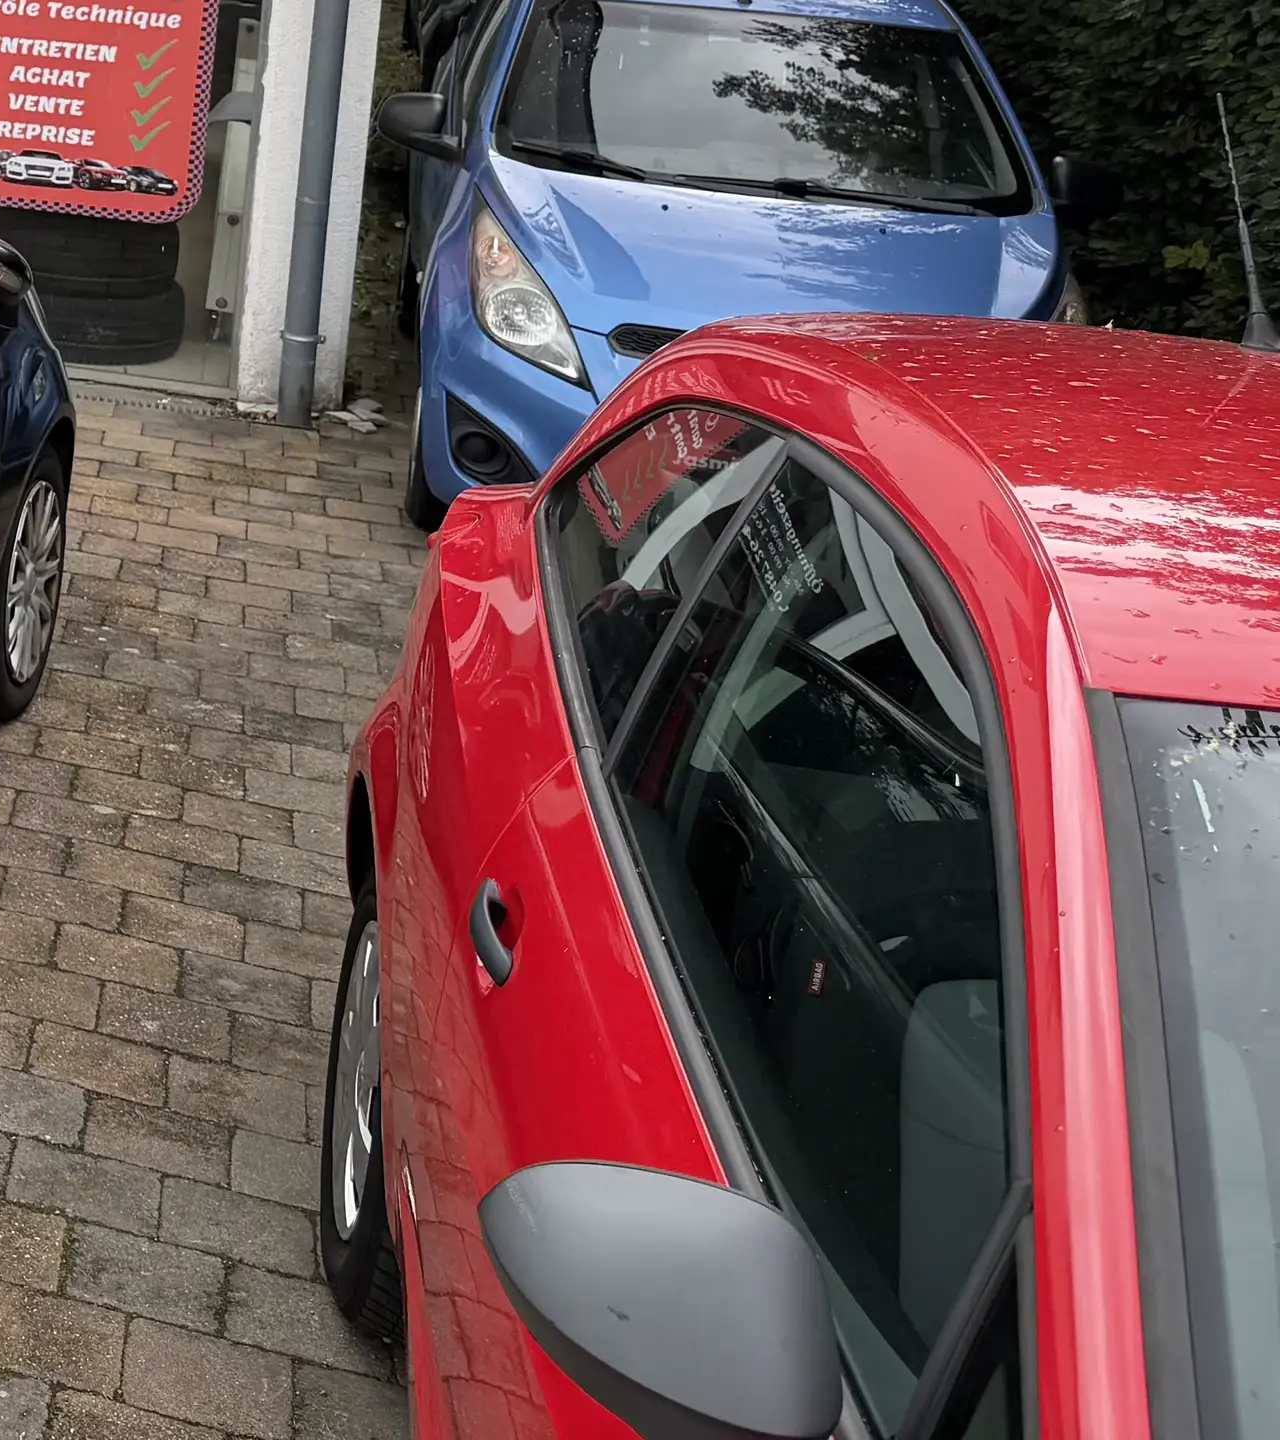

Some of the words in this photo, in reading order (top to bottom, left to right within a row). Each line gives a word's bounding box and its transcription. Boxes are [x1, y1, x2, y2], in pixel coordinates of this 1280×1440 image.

[47, 3, 182, 30] Technique
[9, 65, 91, 89] ACHAT
[8, 92, 85, 117] VENTE
